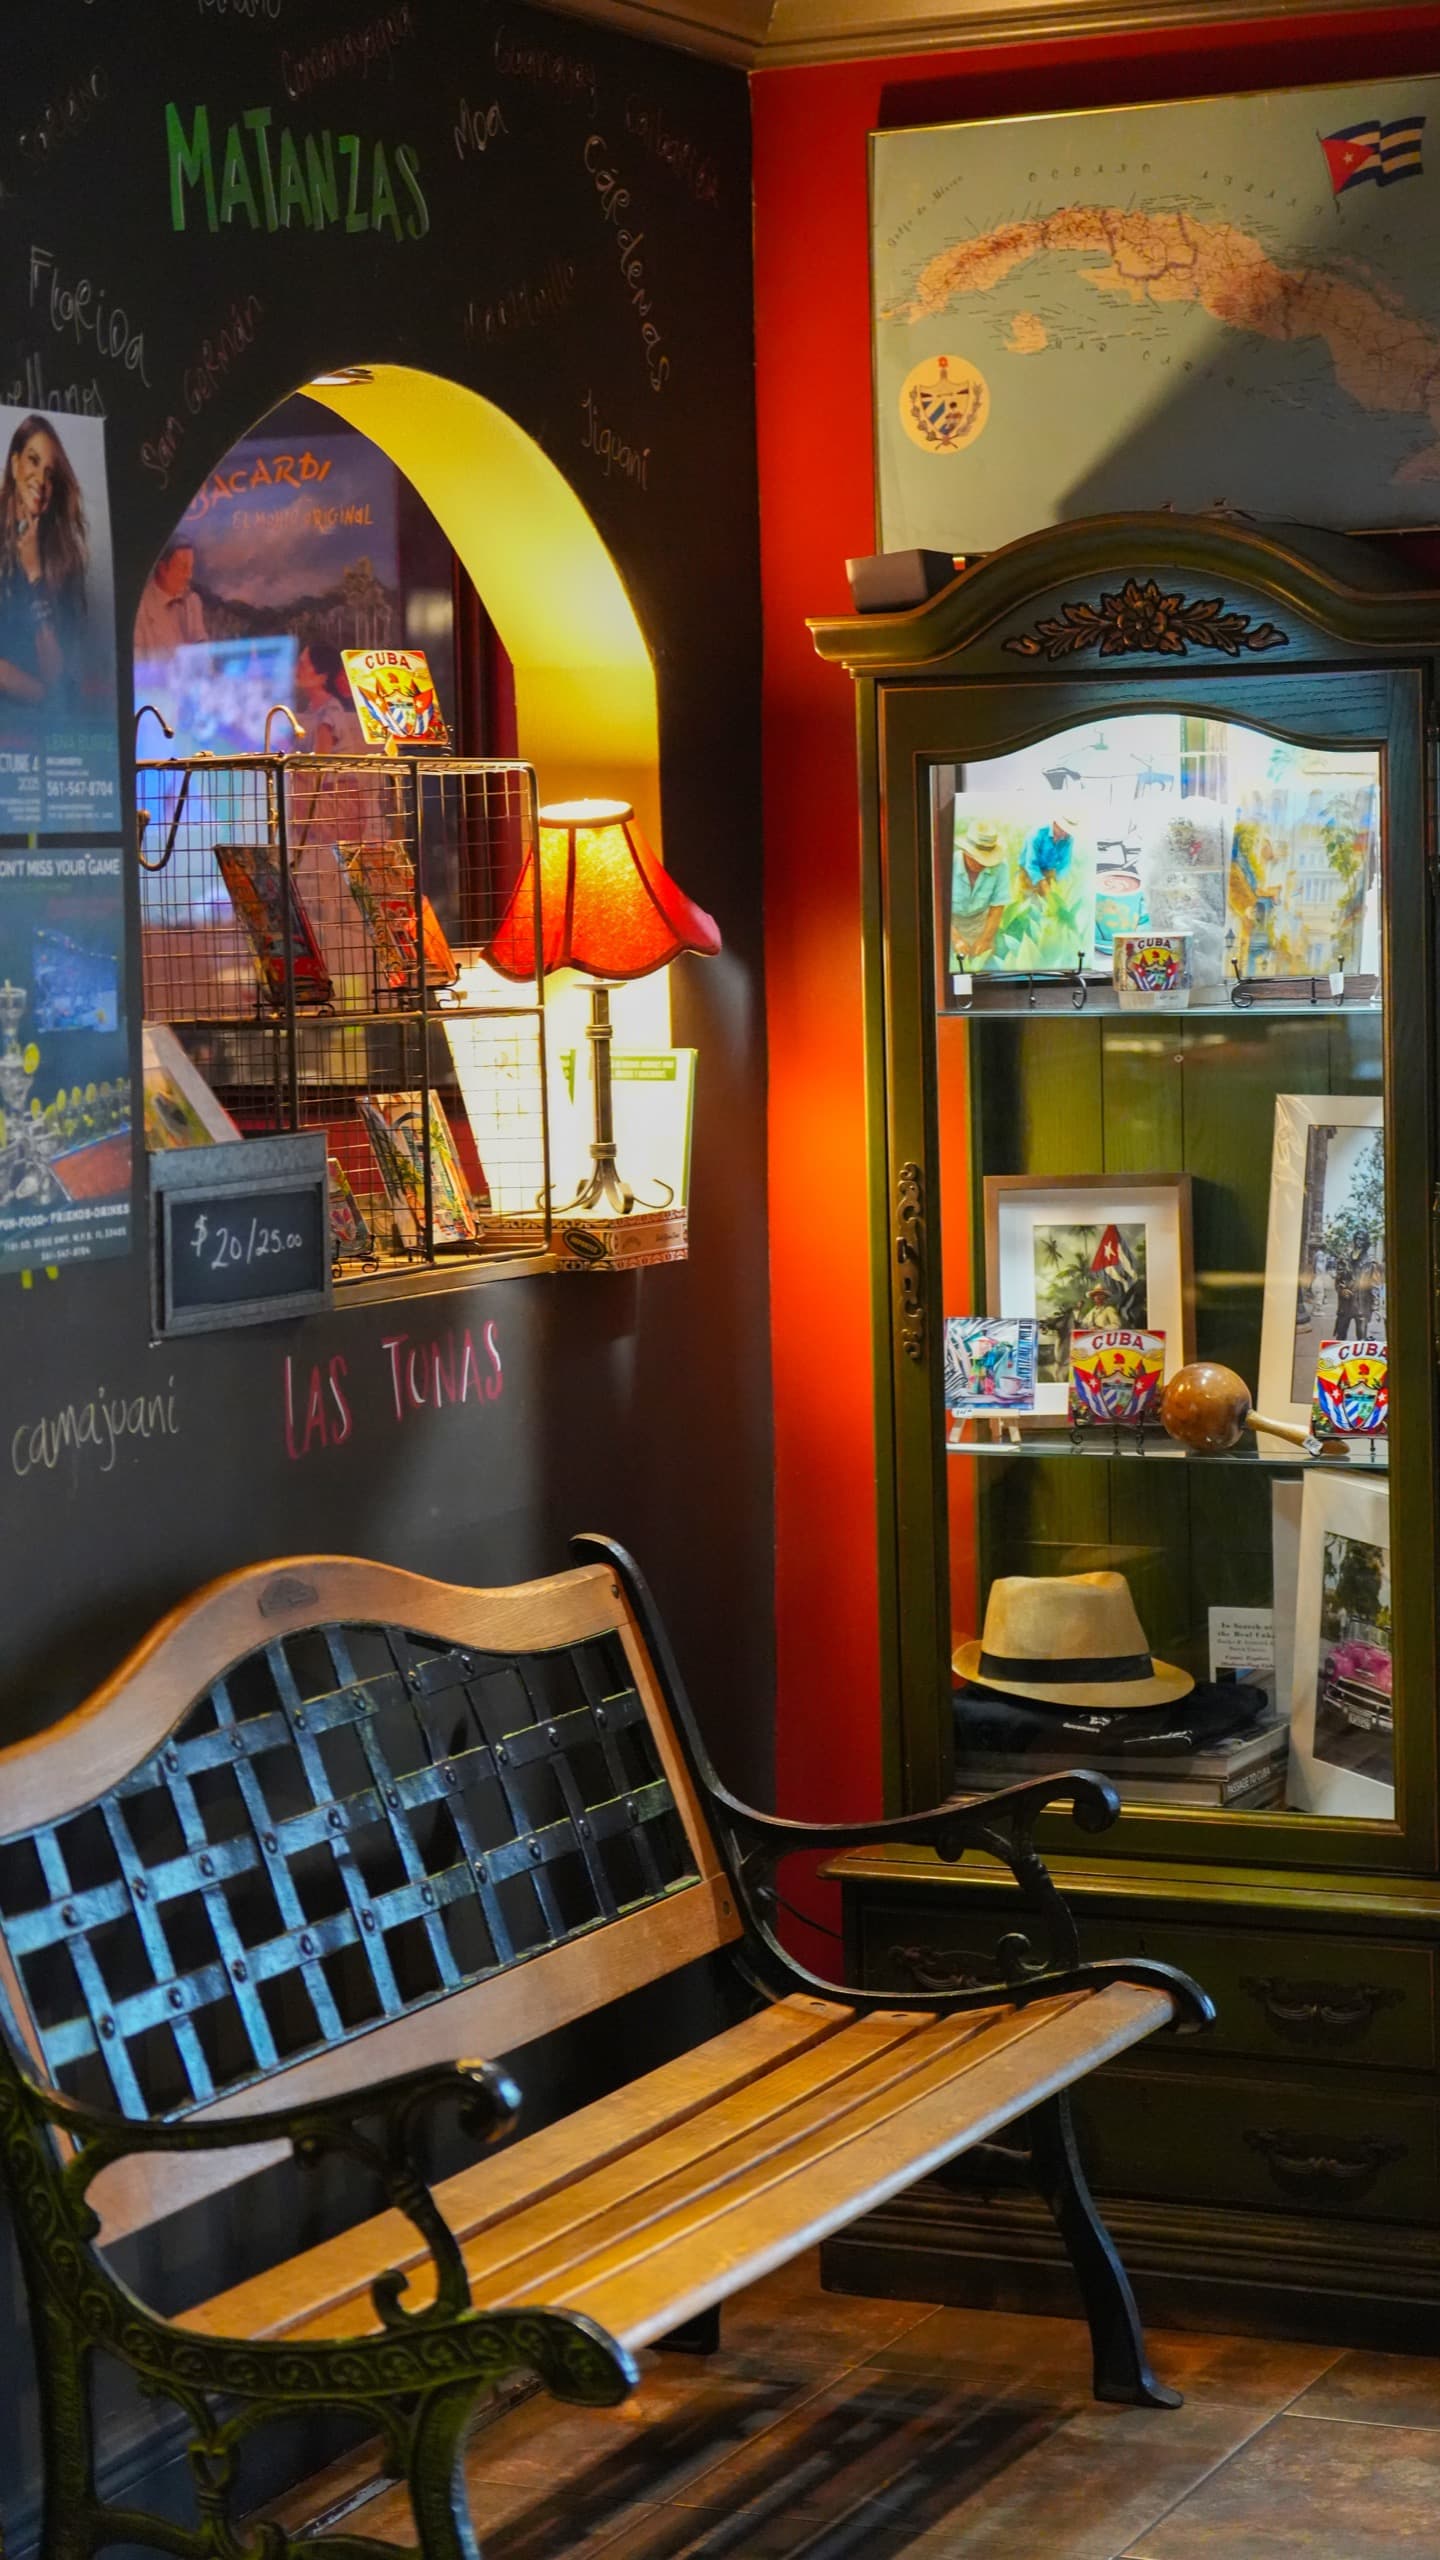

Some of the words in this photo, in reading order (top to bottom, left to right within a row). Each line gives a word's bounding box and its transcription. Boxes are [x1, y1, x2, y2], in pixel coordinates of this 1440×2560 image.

[165, 101, 430, 243] MATANZAS
[365, 651, 412, 670] CUBA
[27, 859, 53, 876] MISS
[55, 858, 86, 876] YOUR
[88, 858, 120, 875] GAME
[1137, 938, 1171, 949] CUBA
[1092, 1332, 1144, 1352] CUBA
[282, 1355, 352, 1459] LAS
[382, 1319, 504, 1420] TUNAS
